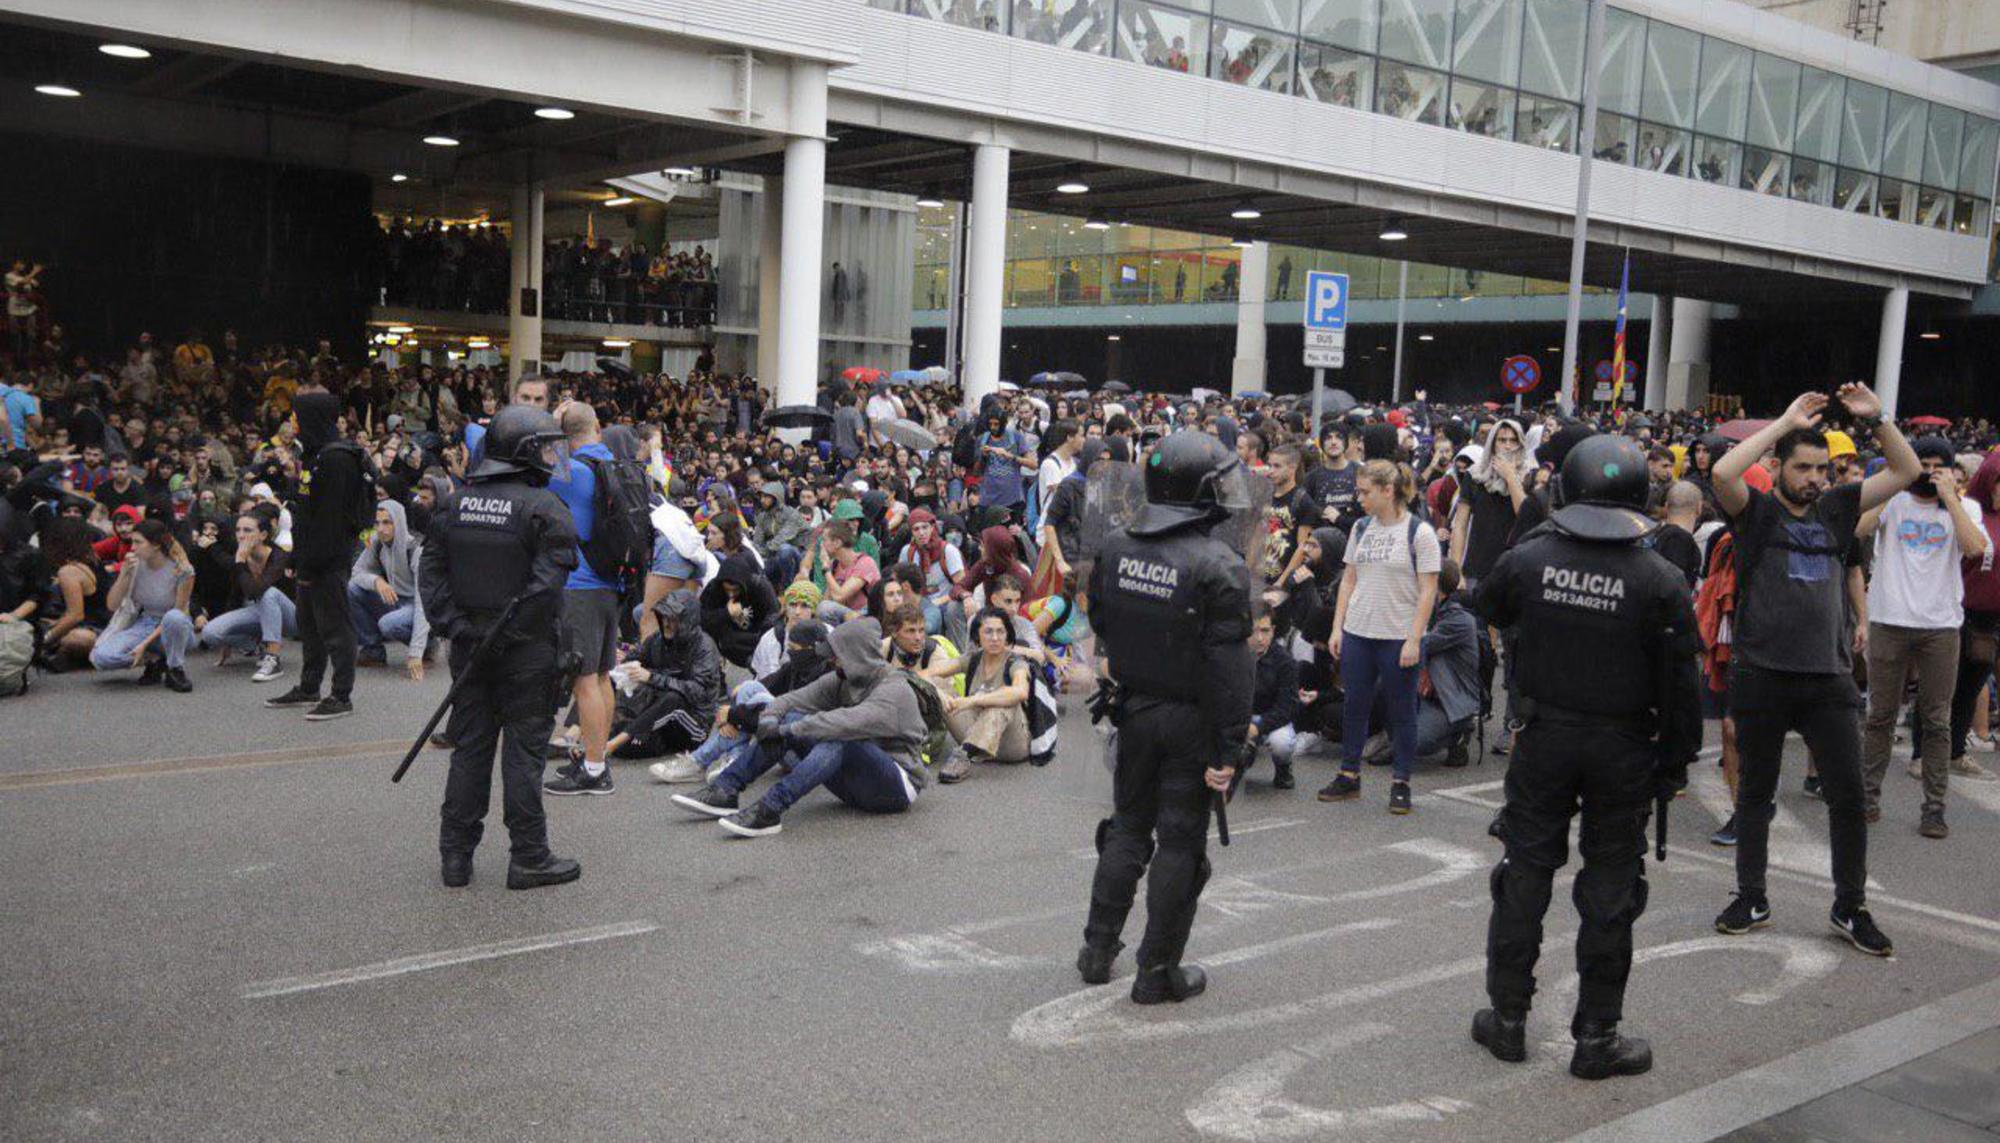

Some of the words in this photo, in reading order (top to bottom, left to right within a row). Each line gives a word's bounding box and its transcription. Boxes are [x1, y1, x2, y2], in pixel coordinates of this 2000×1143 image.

[1314, 279, 1340, 322] P
[1316, 334, 1333, 344] BUS
[459, 496, 512, 515] POLICIA
[1118, 557, 1178, 587] POLICIA
[1541, 565, 1625, 599] POLICIA
[1543, 588, 1617, 612] D513A0211
